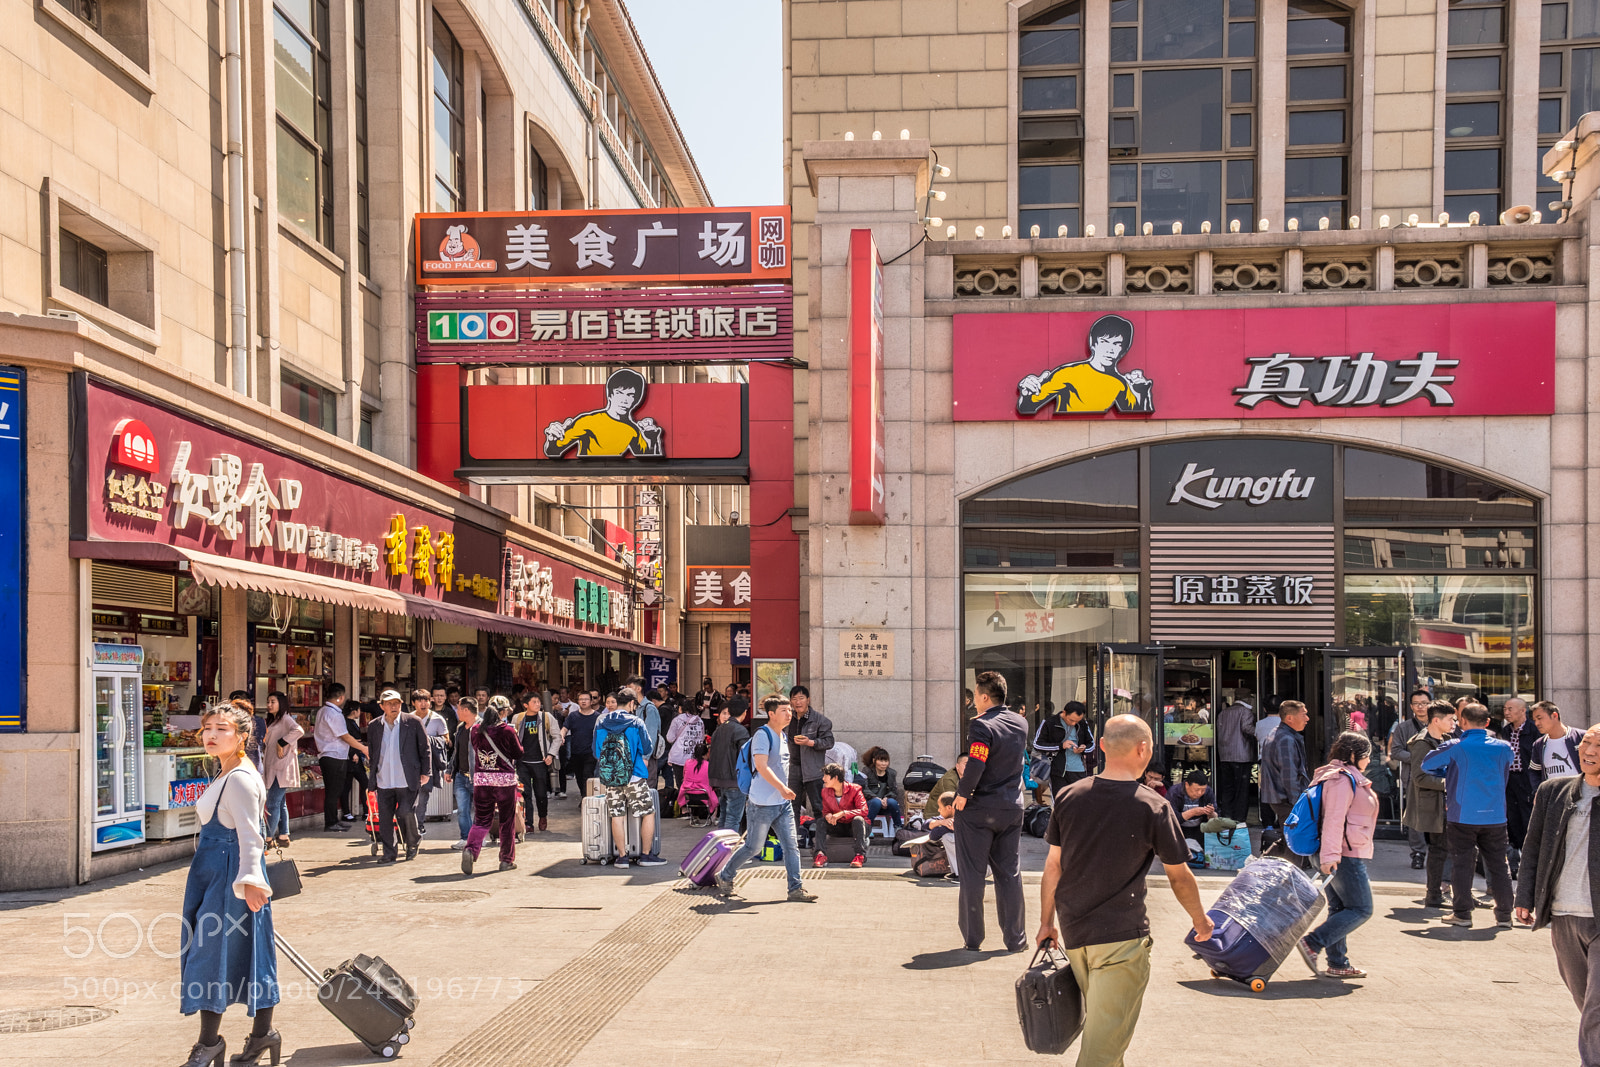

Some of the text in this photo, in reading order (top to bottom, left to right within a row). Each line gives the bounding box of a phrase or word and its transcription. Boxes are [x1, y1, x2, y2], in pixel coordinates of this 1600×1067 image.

[505, 220, 746, 271] 美食广场
[759, 216, 785, 268] 网咖
[425, 261, 493, 270] FOOD PALACE
[431, 312, 517, 341] 100
[530, 306, 778, 341] 易佰连锁旅店
[1232, 351, 1460, 409] 真功夫
[170, 441, 308, 555] 红螺食品
[1169, 463, 1315, 510] Kungfu
[638, 490, 659, 580] 区寄存处
[1174, 575, 1314, 605] 原盅蒸饭
[855, 633, 879, 641] 公告
[174, 781, 211, 804] 冰镇饮
